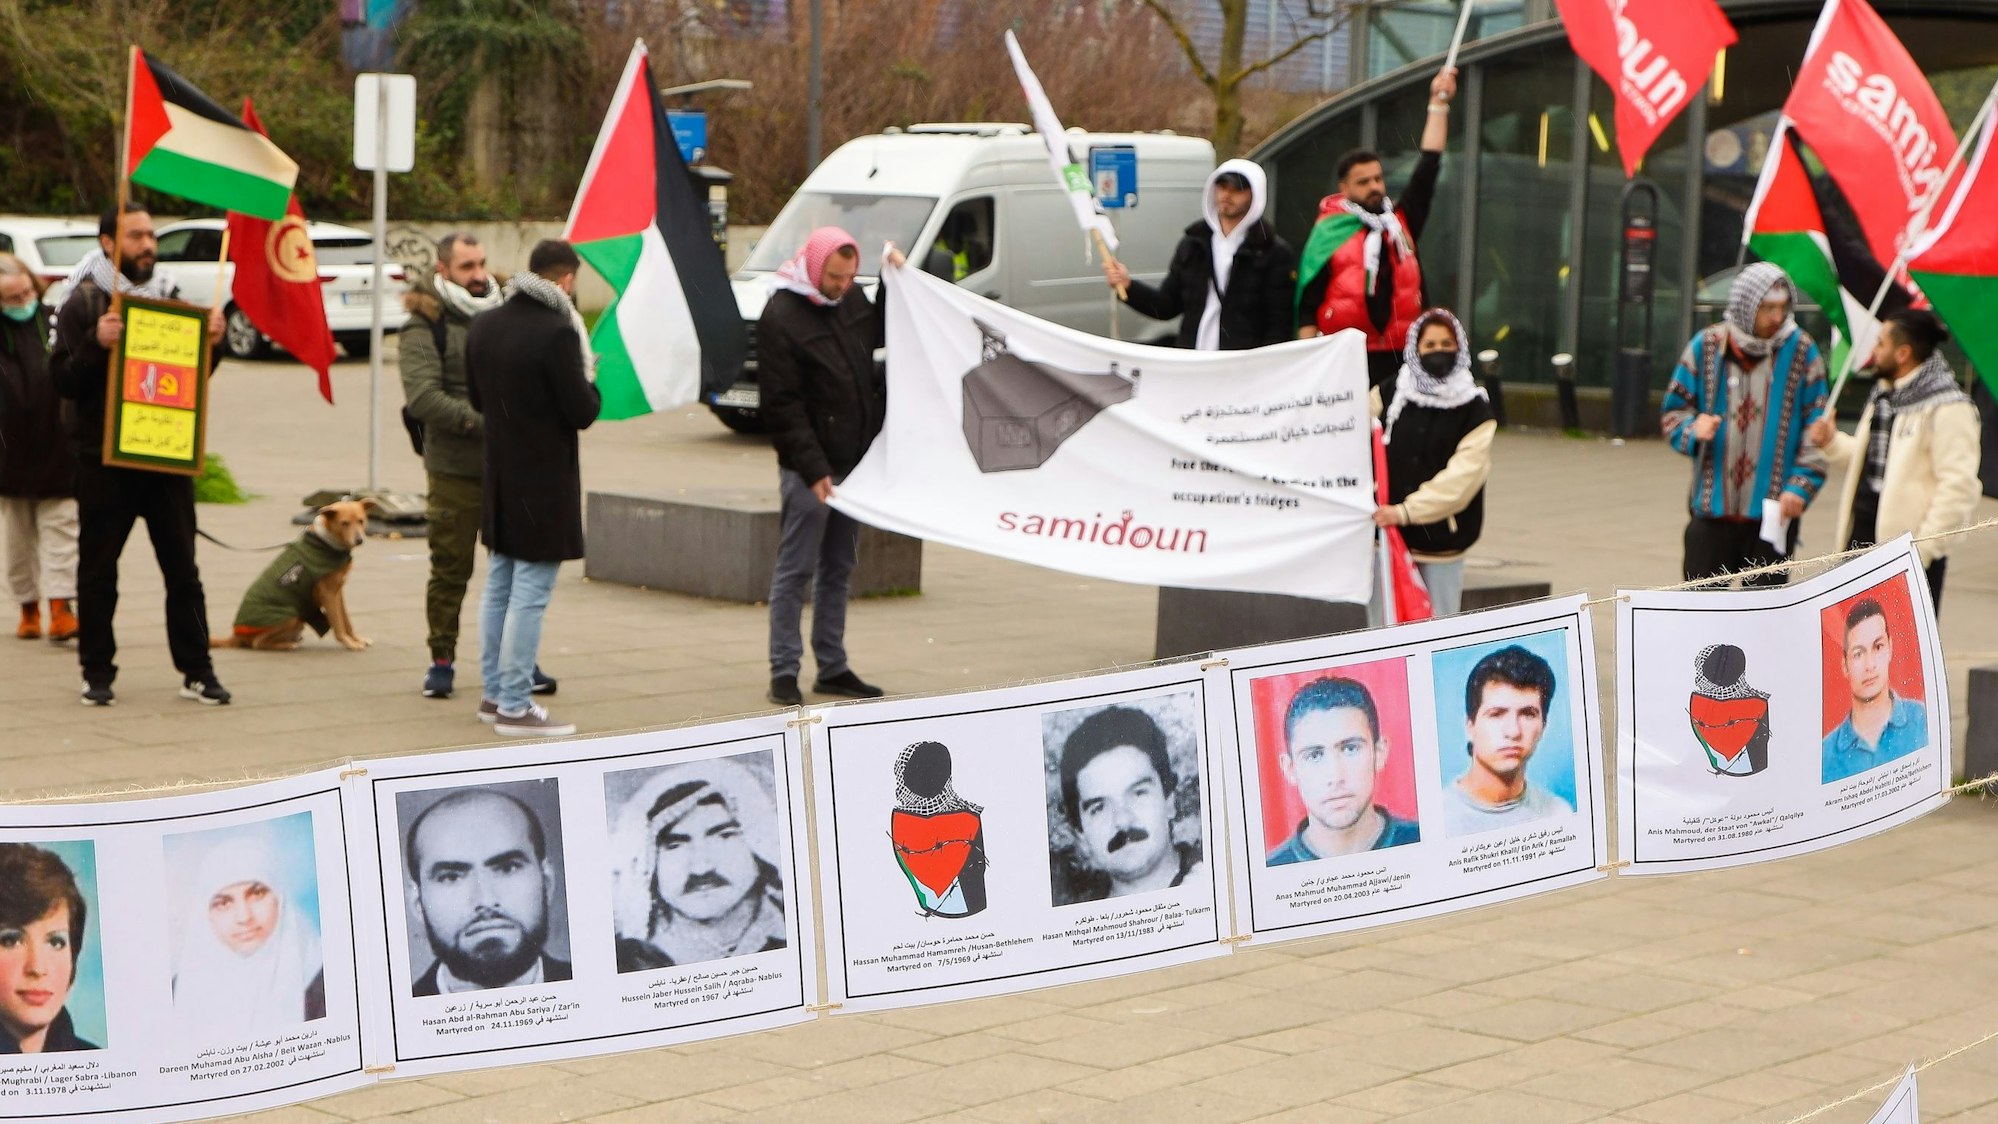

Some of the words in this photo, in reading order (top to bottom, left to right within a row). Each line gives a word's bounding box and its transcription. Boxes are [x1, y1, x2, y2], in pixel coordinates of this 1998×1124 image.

[1337, 476, 1359, 487] the
[998, 509, 1208, 553] samidoun
[1841, 798, 1865, 811] Martyred
[1673, 836, 1705, 844] Martyred
[1718, 830, 1753, 840] 31.08.1980
[1449, 859, 1462, 867] Anis
[1464, 855, 1479, 864] Rafik
[1480, 851, 1499, 860] Shukri
[1500, 846, 1520, 856] Khalil/
[1532, 841, 1544, 849] Arik
[1550, 834, 1576, 845] Ramallah
[1464, 862, 1491, 873] Martyred
[1503, 852, 1536, 865] 11.11.1991
[1294, 887, 1325, 897] Mahmud
[1327, 880, 1367, 892] Muhammad
[1290, 898, 1321, 908] Martyred
[1334, 890, 1370, 901] 20.04.2003
[1065, 927, 1091, 937] Mithqal
[1093, 921, 1127, 932] Mahmoud
[1129, 917, 1158, 926] Shahrour
[1164, 912, 1184, 920] Balaa-
[1185, 907, 1210, 916] Tulkarm
[1073, 935, 1104, 946] Martyred
[1116, 927, 1154, 939] 13/11/1983
[853, 958, 879, 966] Hassan
[881, 951, 925, 962] Muhammad
[927, 946, 966, 957] Hamamreh
[968, 938, 1033, 952] /Husan-Bethlehem
[887, 962, 921, 972] Martyred
[938, 956, 970, 967] 7/5/1969
[622, 993, 650, 1002] Hussein
[674, 986, 702, 995] Hussein
[704, 982, 721, 991] Salih
[728, 977, 756, 987] Aqraba-
[758, 973, 782, 982] Nablus
[654, 998, 688, 1008] Martyred
[702, 993, 718, 1002] 1967
[448, 1015, 464, 1023] Abd
[466, 1012, 508, 1021] al-Rahman
[527, 1006, 550, 1014] Sariya
[436, 1025, 472, 1035] Martyred
[491, 1018, 533, 1029] 24.11.1969
[160, 1066, 188, 1074] Dareen
[191, 1058, 232, 1070] Muhamad
[234, 1056, 250, 1064] Abu
[252, 1052, 273, 1060] Aisha
[281, 1046, 295, 1055] Beit
[297, 1042, 322, 1051] Wazan
[324, 1034, 350, 1045] -Nablus
[51, 1076, 73, 1084] Lager
[101, 1071, 136, 1079] -Libanon
[190, 1069, 228, 1081] Martyred
[242, 1060, 284, 1073] 27.02.2002
[26, 1086, 66, 1095] 3.11.1978
